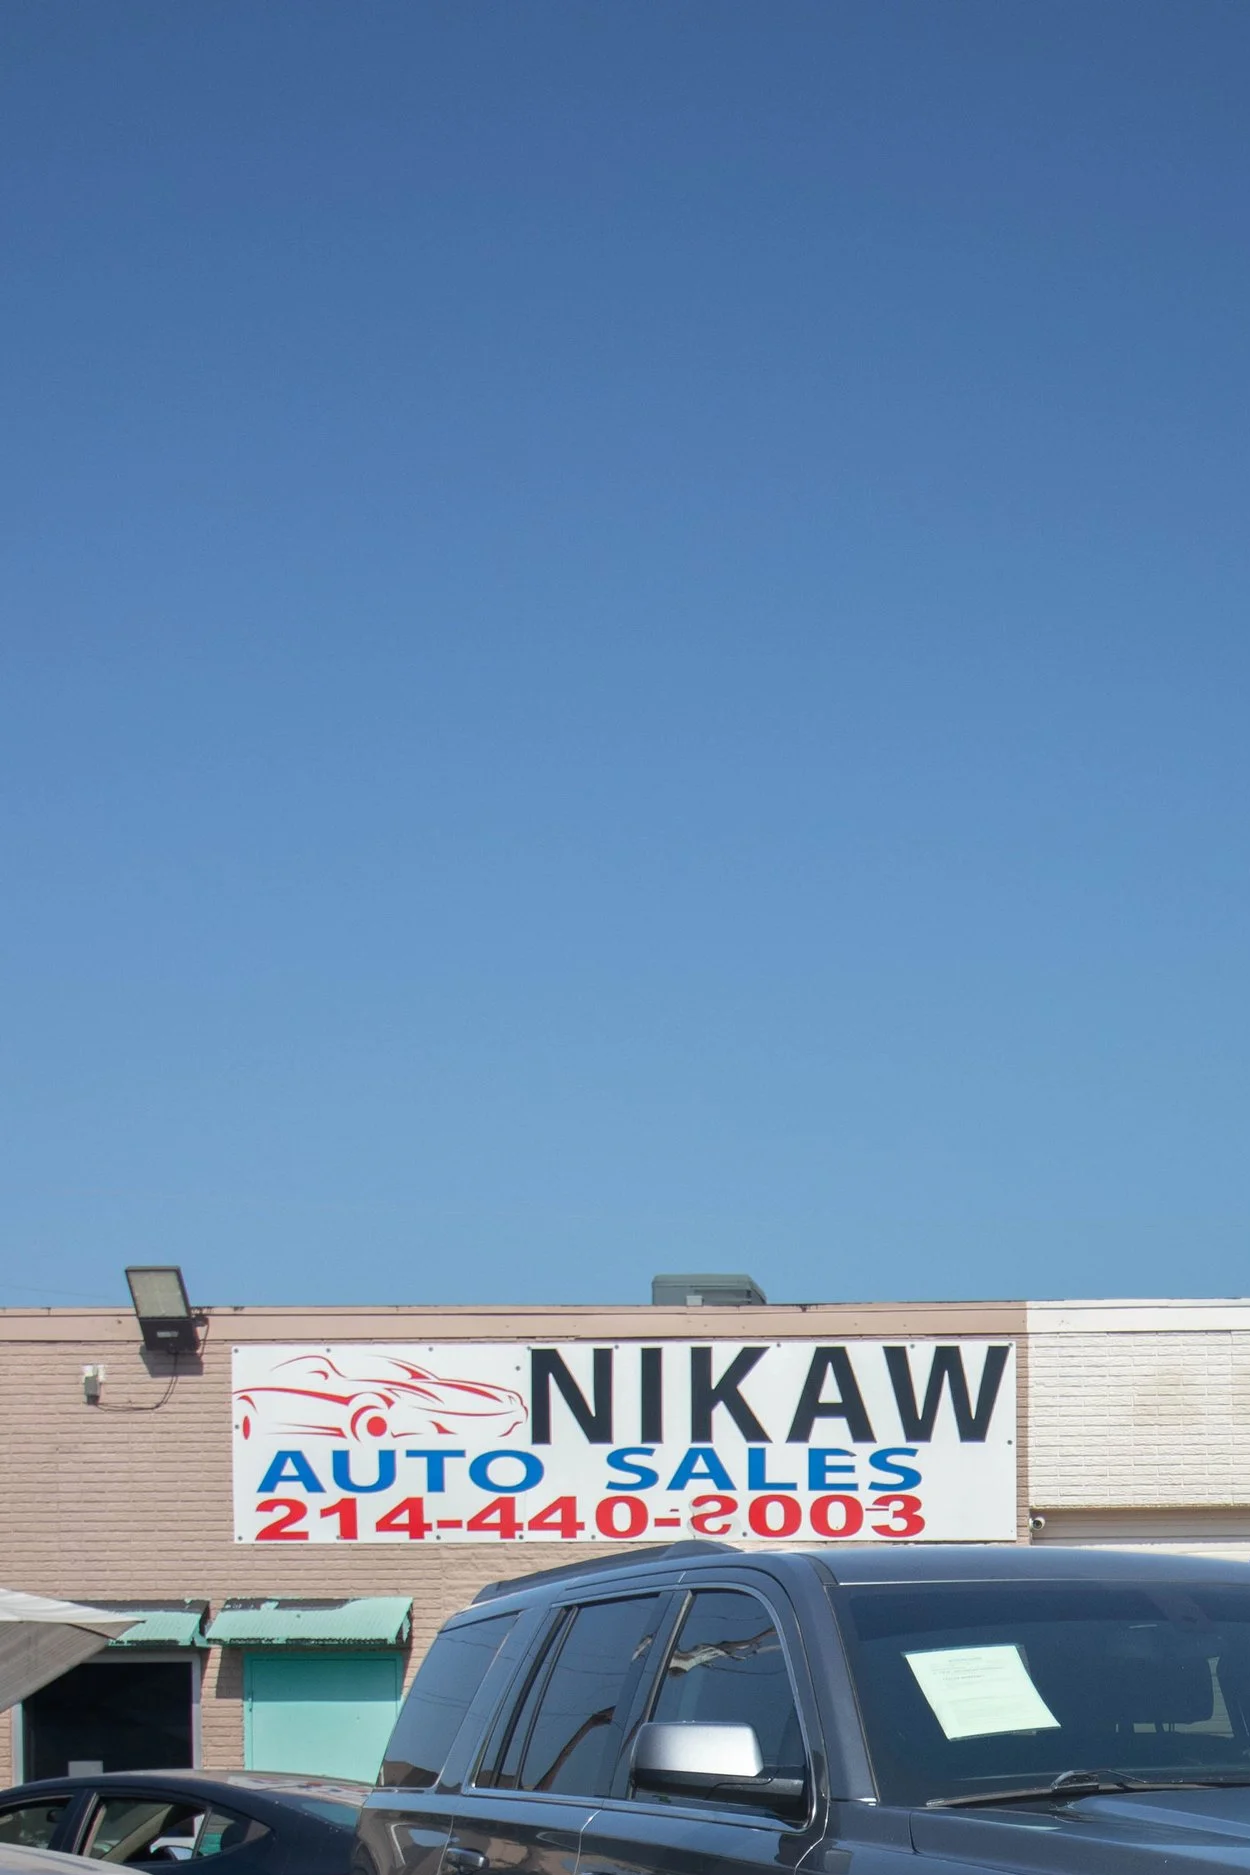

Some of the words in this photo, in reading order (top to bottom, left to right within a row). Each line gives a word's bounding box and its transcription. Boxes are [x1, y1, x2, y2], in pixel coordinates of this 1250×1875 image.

[531, 1345, 1009, 1444] NIKAW
[257, 1449, 544, 1494] AUTO
[606, 1447, 922, 1492] SALES
[256, 1494, 925, 1540] 214-440-2003
